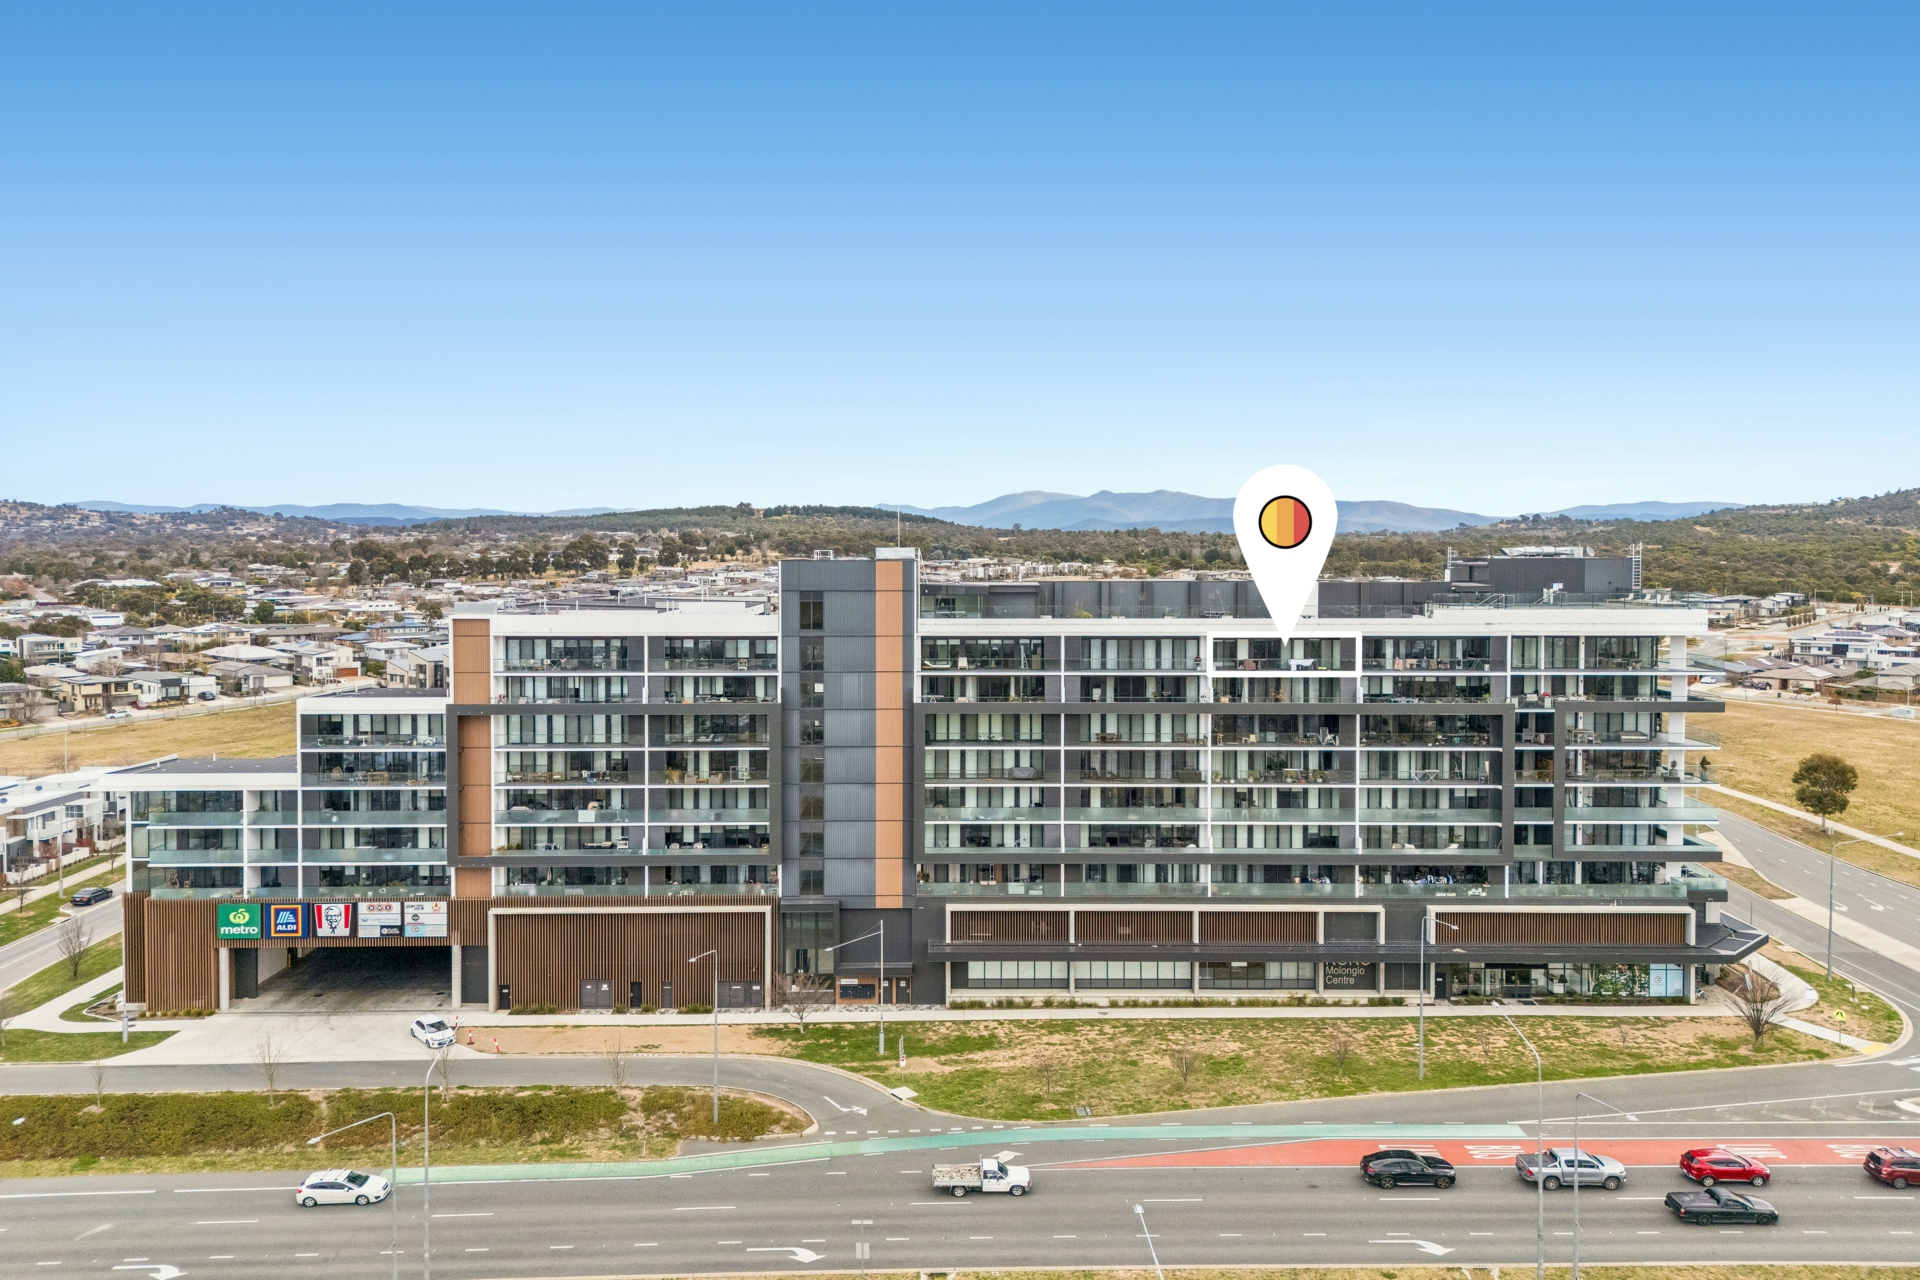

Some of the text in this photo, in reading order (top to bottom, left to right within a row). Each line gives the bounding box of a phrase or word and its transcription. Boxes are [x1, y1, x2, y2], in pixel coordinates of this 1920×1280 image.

[220, 925, 258, 934] metro
[1326, 966, 1365, 977] Molonglo
[1326, 975, 1355, 984] Centre
[1464, 1145, 1526, 1160] BUS
